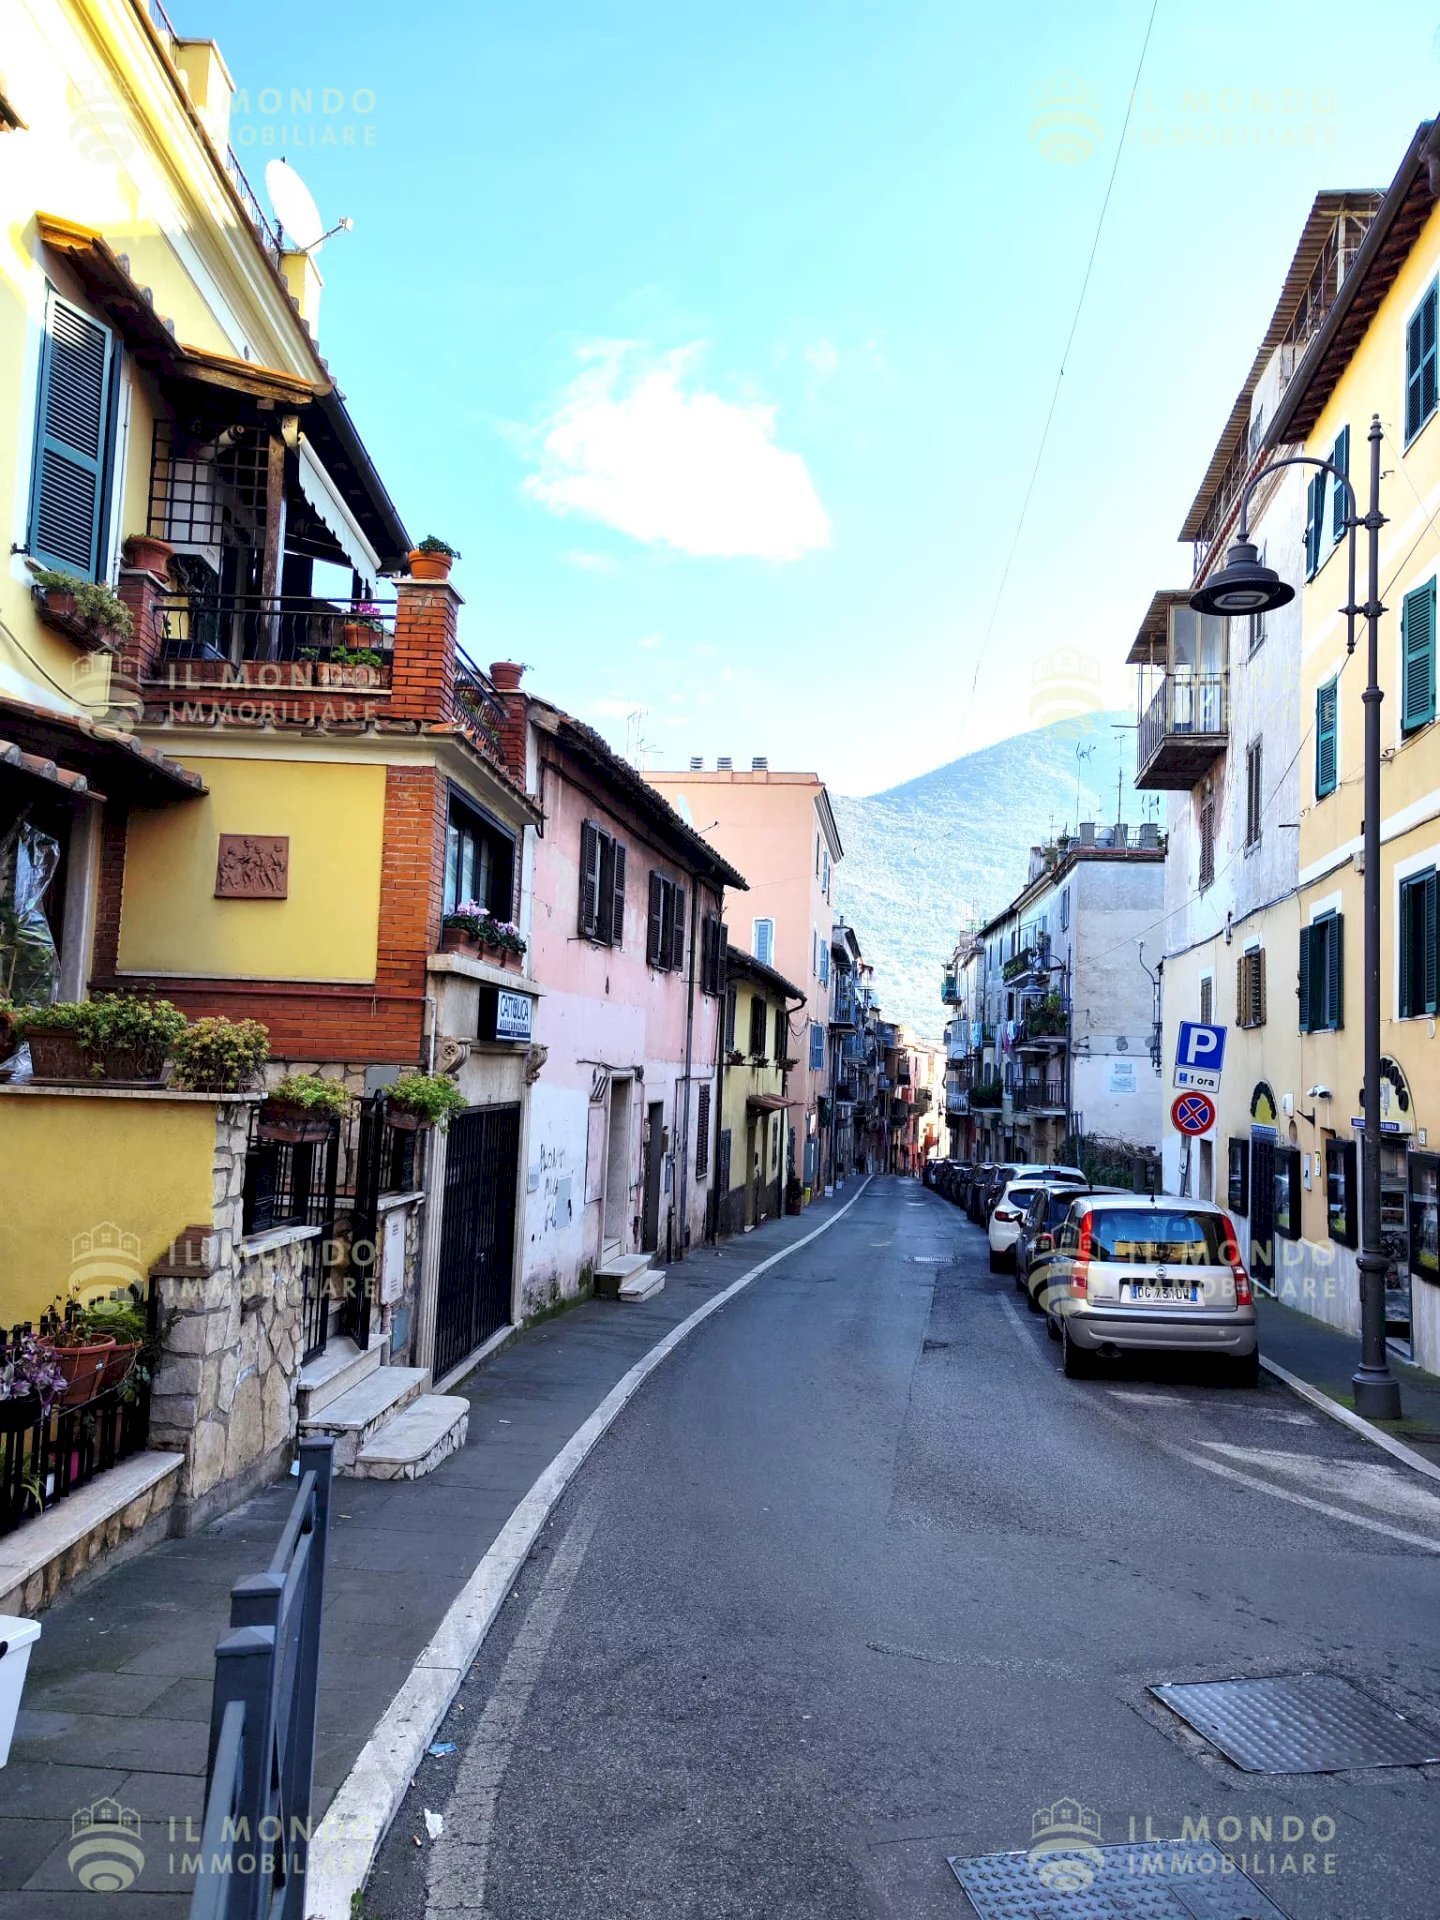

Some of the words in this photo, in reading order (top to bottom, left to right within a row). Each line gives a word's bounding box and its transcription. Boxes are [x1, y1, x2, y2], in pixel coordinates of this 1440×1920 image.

[1186, 1027, 1218, 1064] P
[1190, 1075, 1195, 1084] 1
[1197, 1077, 1214, 1087] ora
